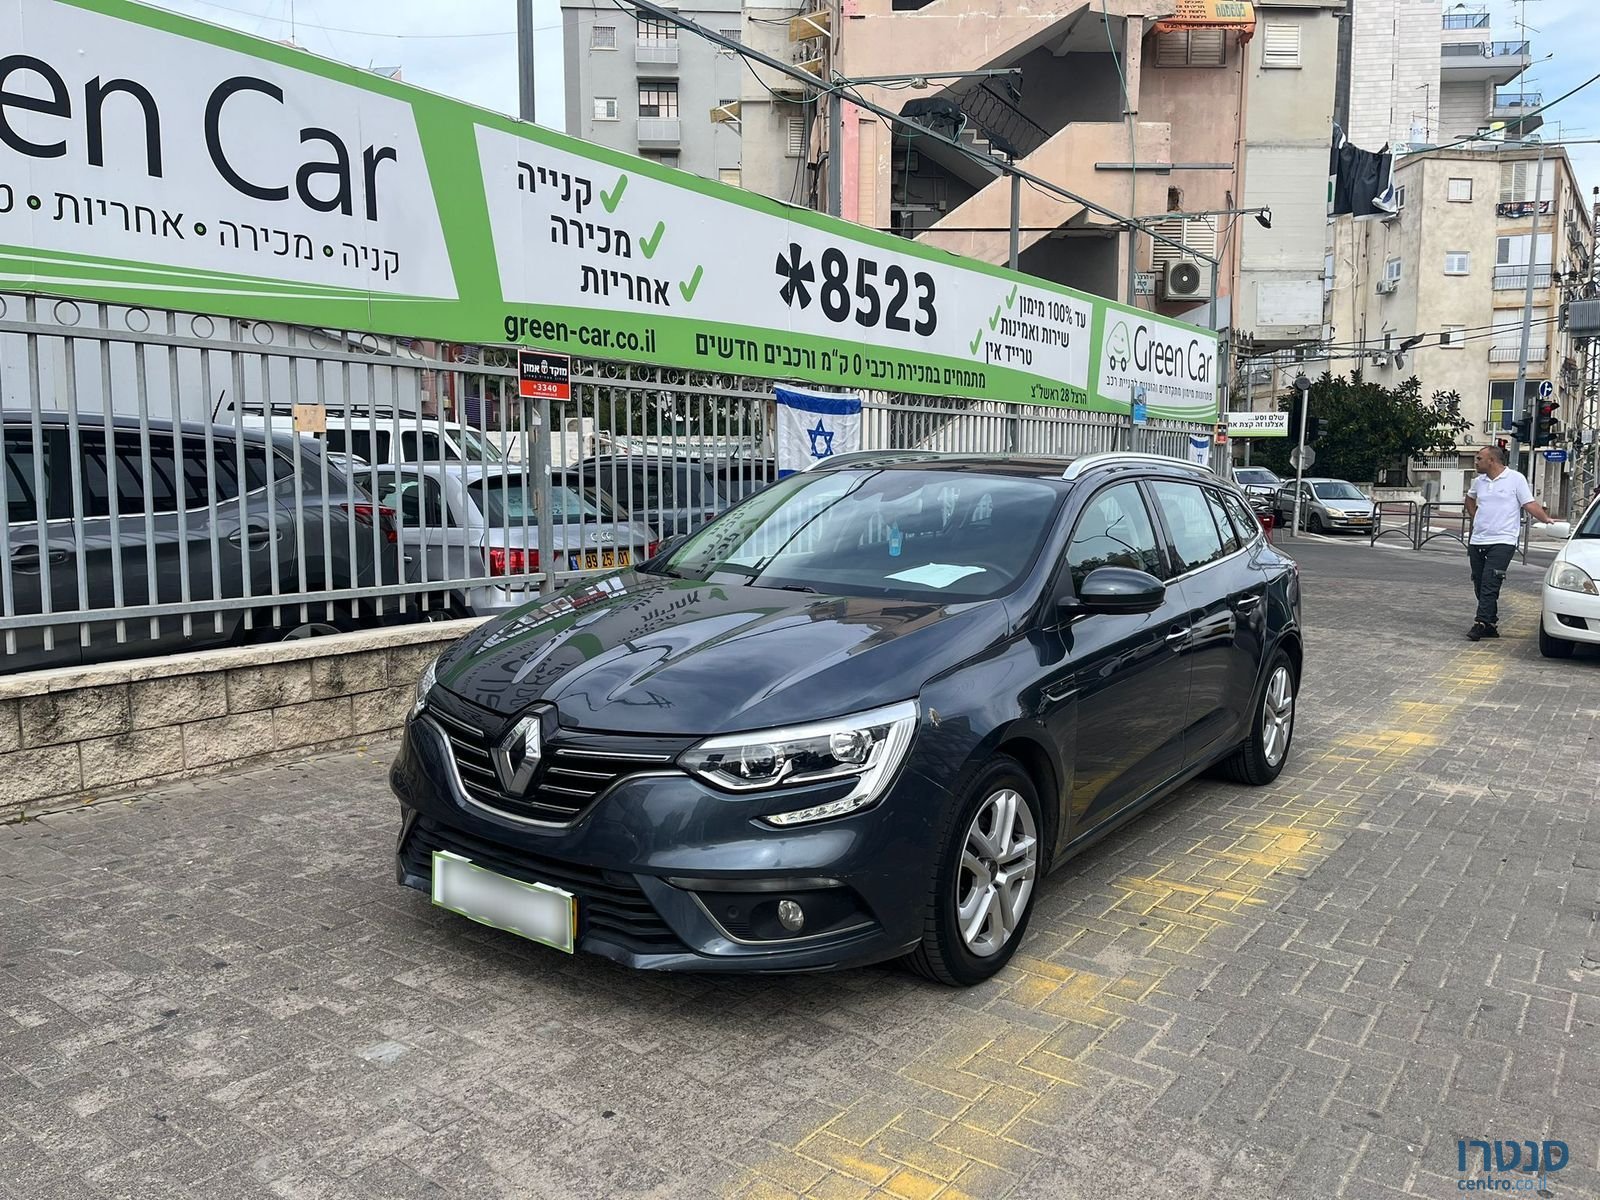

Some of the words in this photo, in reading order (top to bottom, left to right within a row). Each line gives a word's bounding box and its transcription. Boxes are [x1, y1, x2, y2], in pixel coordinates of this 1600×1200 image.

[204, 76, 397, 222] Car
[517, 161, 592, 213] קנייה
[53, 191, 185, 240] אחריות
[219, 219, 314, 262] מכירה
[550, 214, 632, 258] מכירה
[342, 241, 400, 281] קניה
[580, 264, 671, 306] אחריות
[1019, 295, 1045, 318] מימון
[1048, 301, 1073, 326] 100%
[1000, 317, 1039, 343] ואמינות
[1075, 311, 1086, 329] עד
[504, 315, 656, 353] green-car.co.il
[1041, 326, 1070, 348] שירות
[695, 332, 759, 363] חדשים
[764, 343, 817, 367] ורכבים
[985, 341, 1002, 364] אין
[1005, 345, 1033, 366] טרייד
[1133, 324, 1185, 379] Green
[1187, 339, 1213, 384] Car
[523, 362, 541, 375] אמון
[549, 365, 568, 377] מוקד
[853, 352, 862, 376] 0
[865, 357, 894, 380] רכבי
[897, 361, 941, 385] במכירת
[943, 367, 986, 390] מתמחים
[1060, 387, 1070, 403] 28
